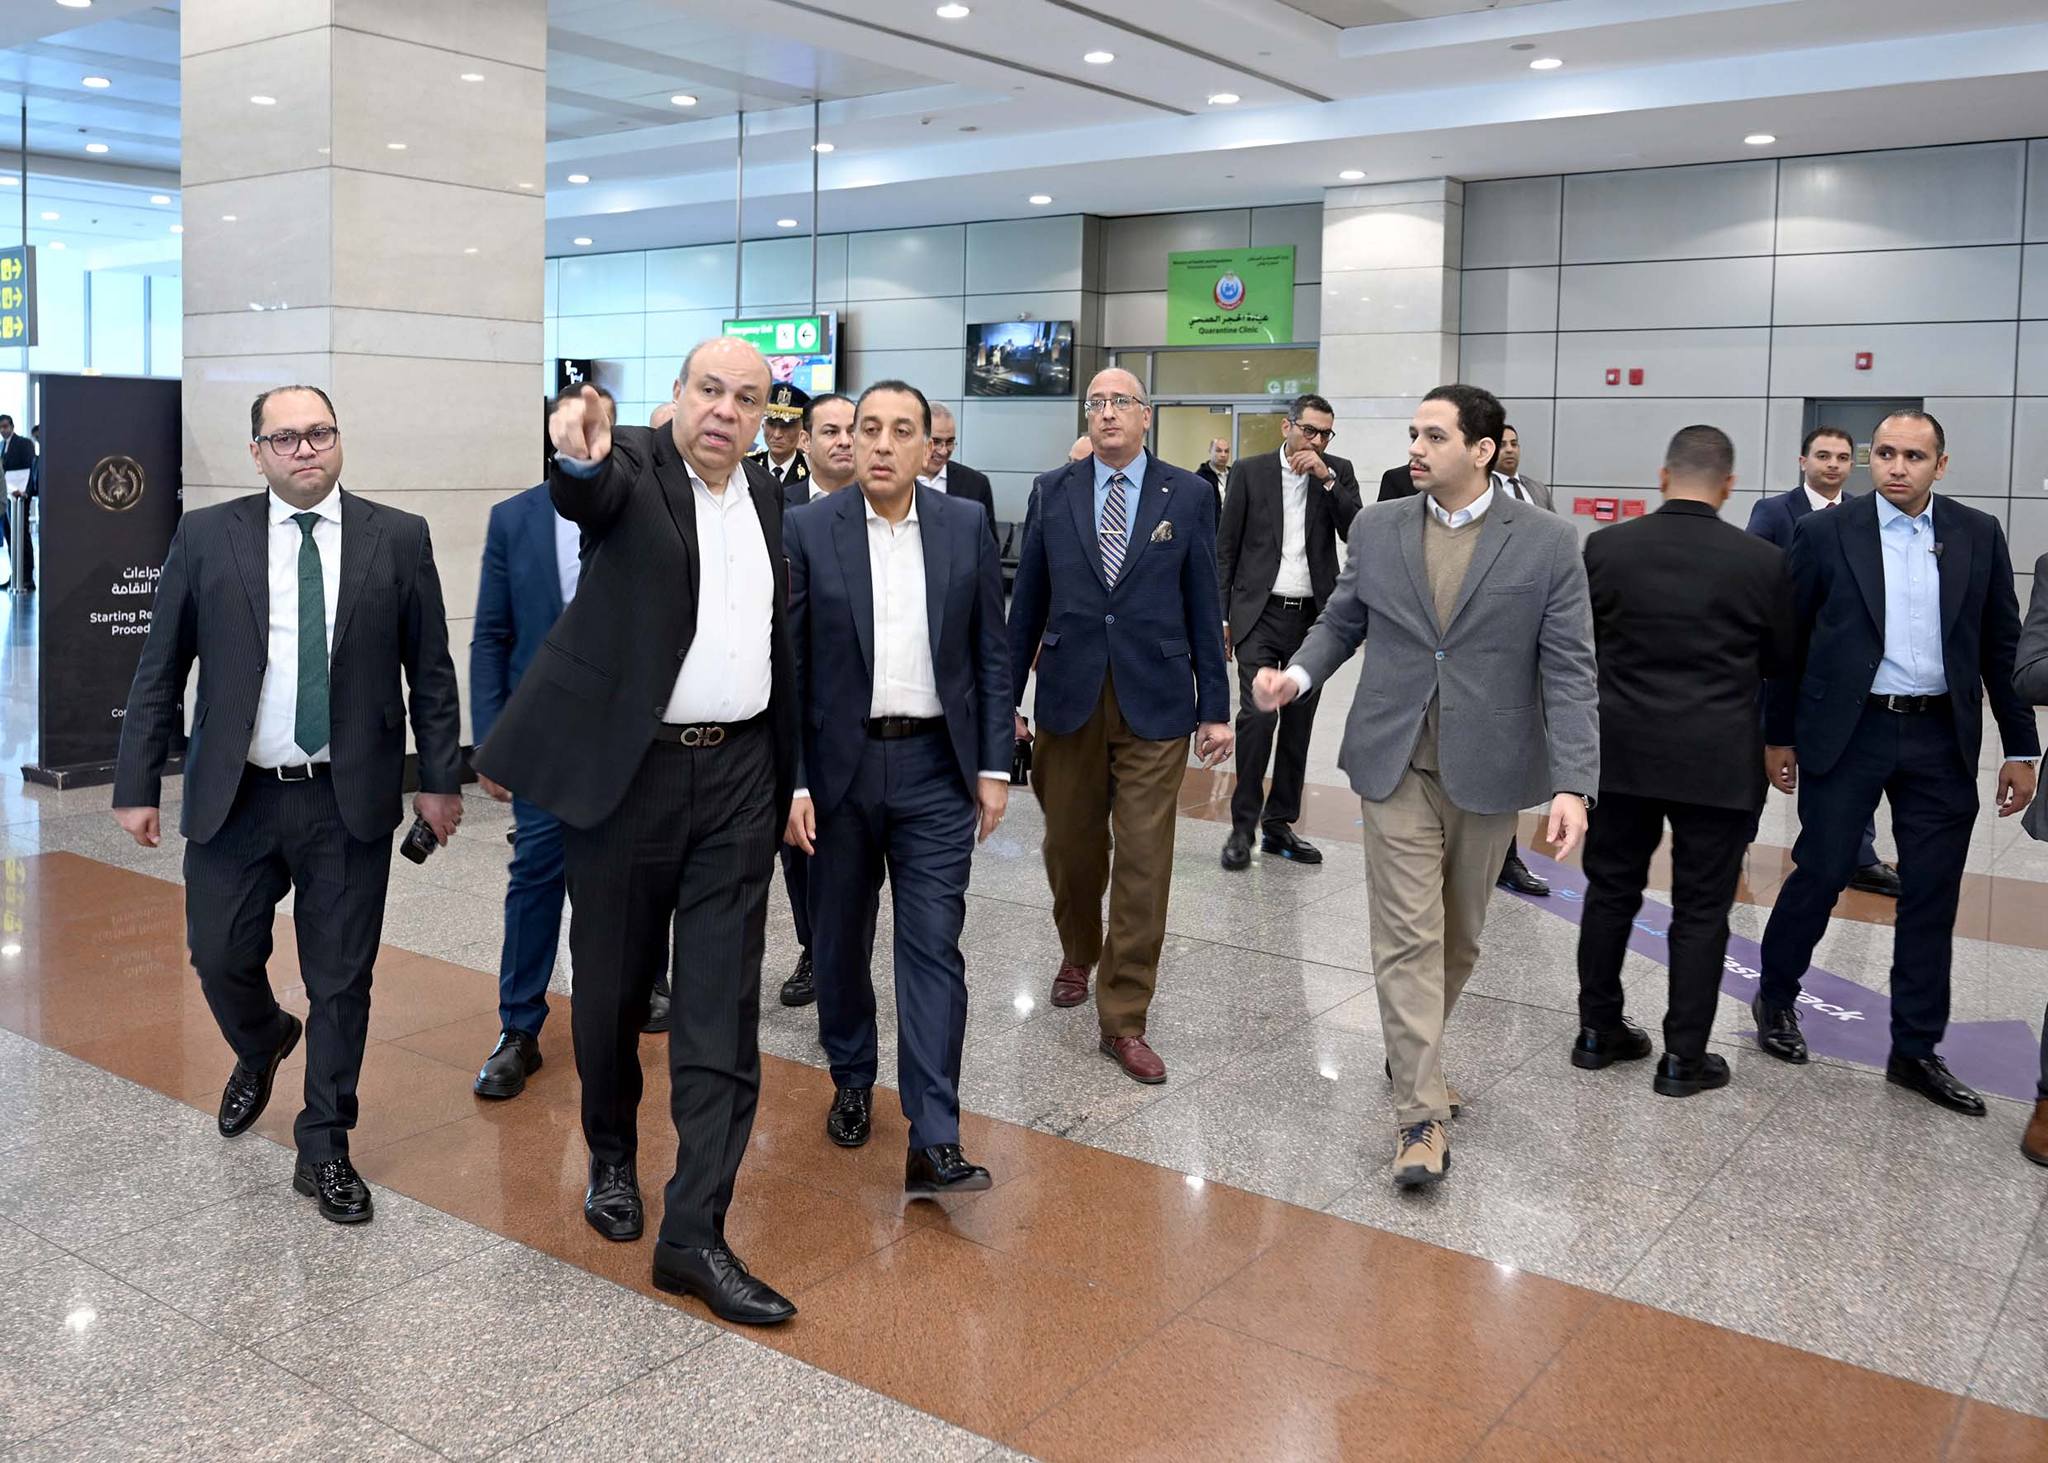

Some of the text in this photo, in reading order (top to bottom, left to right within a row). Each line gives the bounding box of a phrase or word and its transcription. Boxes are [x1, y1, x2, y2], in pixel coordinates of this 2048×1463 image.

[1198, 325, 1259, 335] Quarantine Clinic
[90, 610, 136, 624] Starting
[111, 623, 151, 636] Proced
